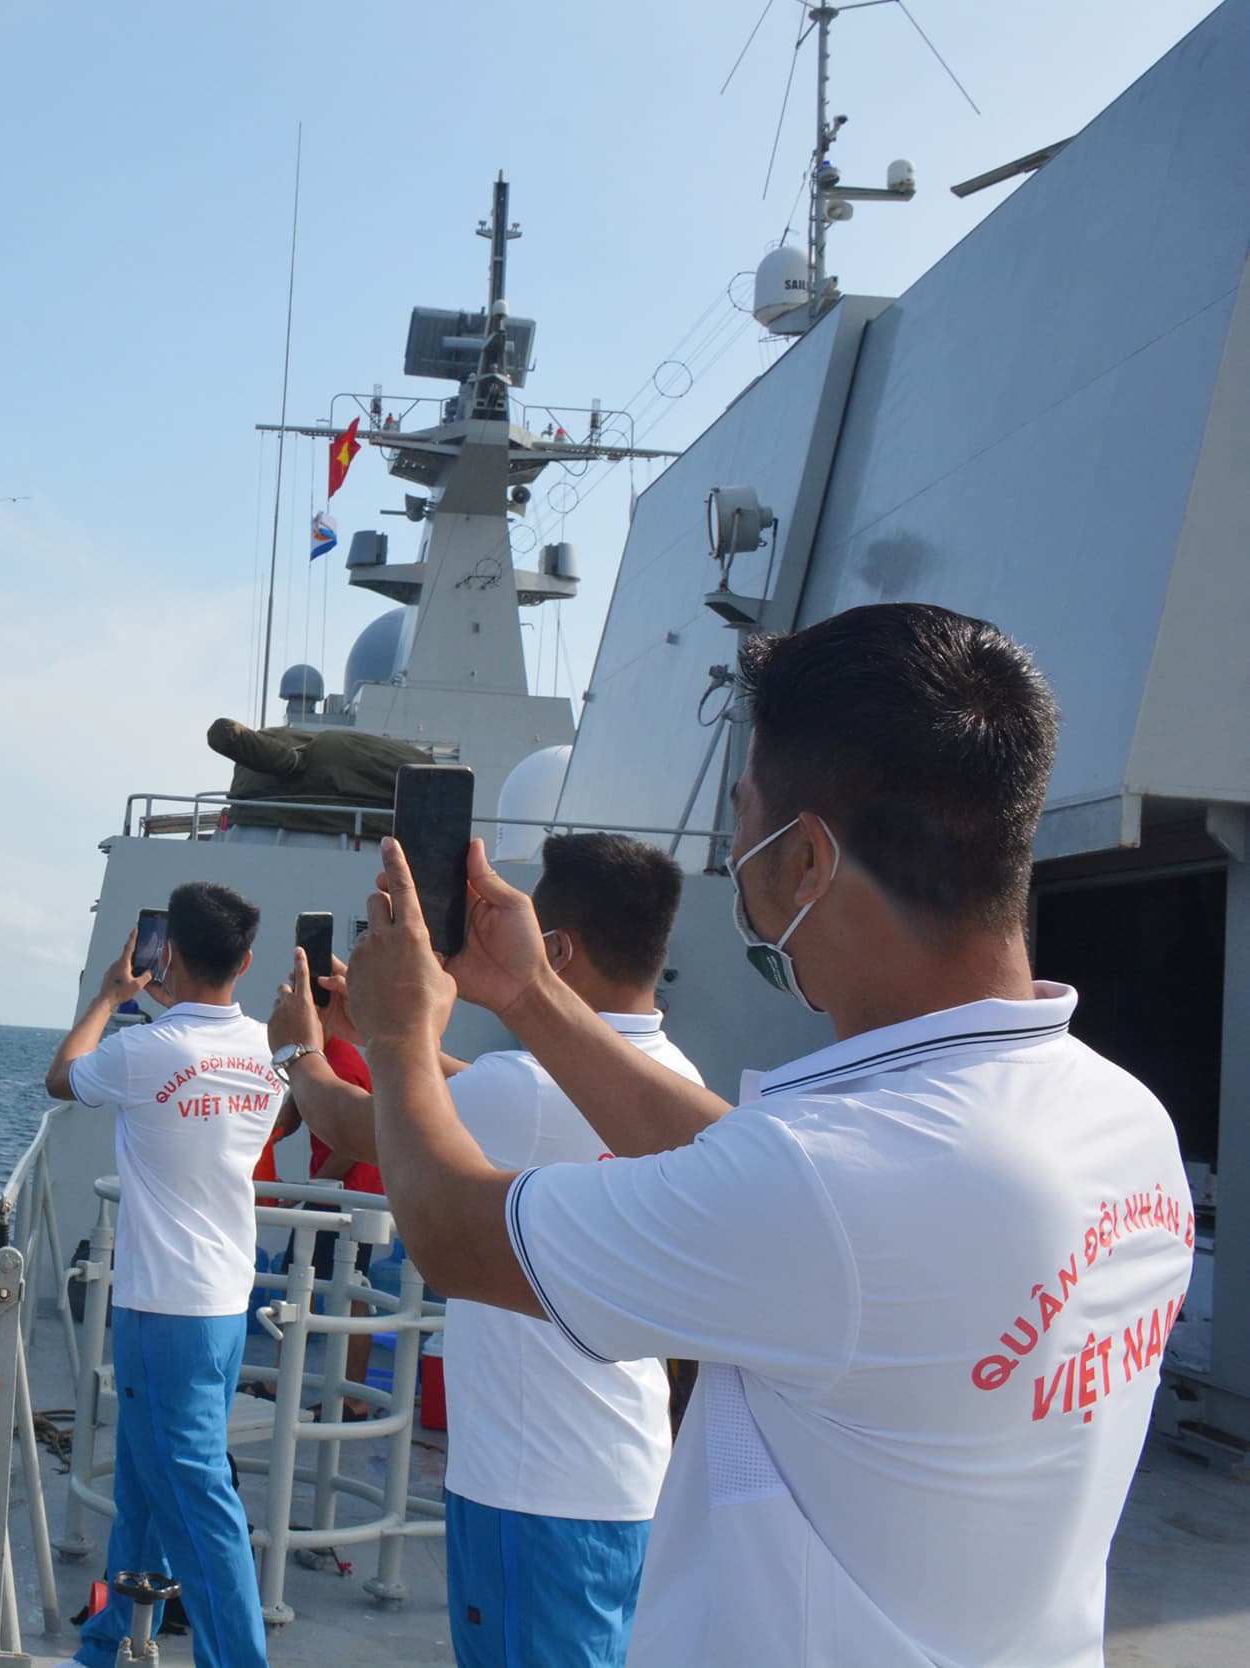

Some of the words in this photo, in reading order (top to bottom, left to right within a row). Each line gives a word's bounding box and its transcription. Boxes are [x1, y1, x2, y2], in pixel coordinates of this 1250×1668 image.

[155, 1065, 197, 1104] QUÂN
[177, 1092, 222, 1121] VIỆT
[228, 1093, 270, 1114] NAM
[970, 1252, 1078, 1391] QUÂN
[1083, 1201, 1121, 1267] ĐỘI
[1123, 1182, 1180, 1236] NHÂN
[1031, 1332, 1113, 1424] VIỆT
